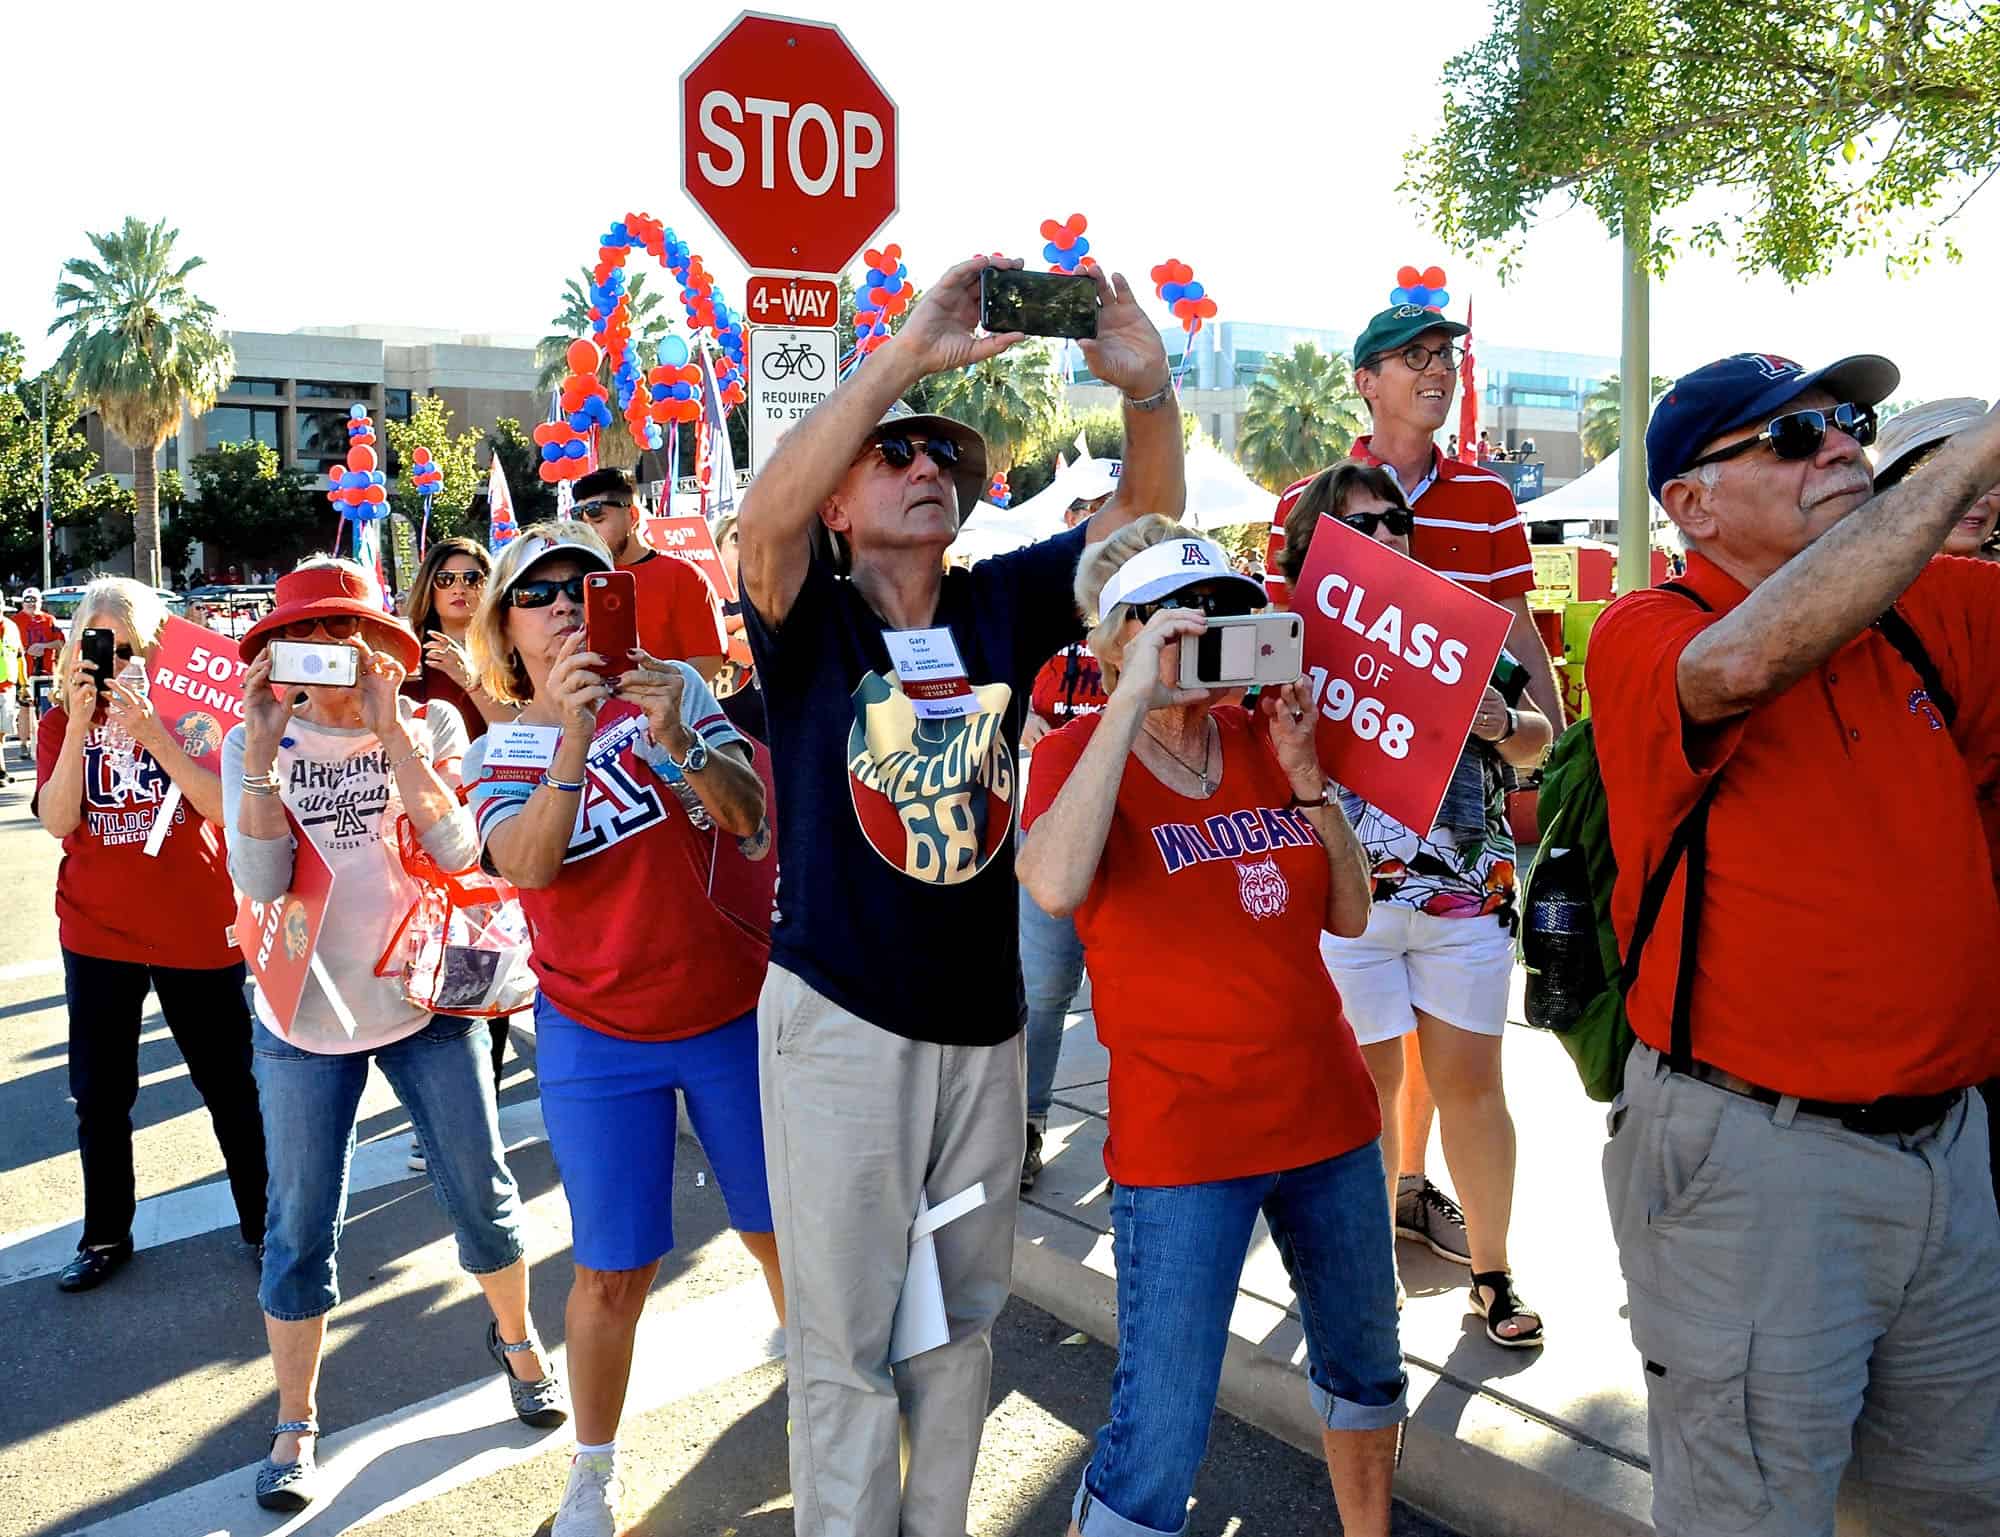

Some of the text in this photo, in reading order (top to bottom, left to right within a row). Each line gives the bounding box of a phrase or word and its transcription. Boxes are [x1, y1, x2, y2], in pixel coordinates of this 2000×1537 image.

[697, 90, 884, 198] STOP
[752, 286, 831, 318] 4-WAY
[762, 391, 826, 403] REQUIRED
[766, 408, 812, 419] TO STO
[664, 528, 696, 546] 50TH
[1182, 543, 1210, 565] A
[1316, 574, 1468, 685] CLASS
[186, 646, 248, 682] 50T
[1354, 653, 1393, 688] OF
[155, 668, 246, 719] REUNIO
[1309, 666, 1415, 759] 1968
[334, 803, 367, 838] A
[899, 792, 977, 883] 68
